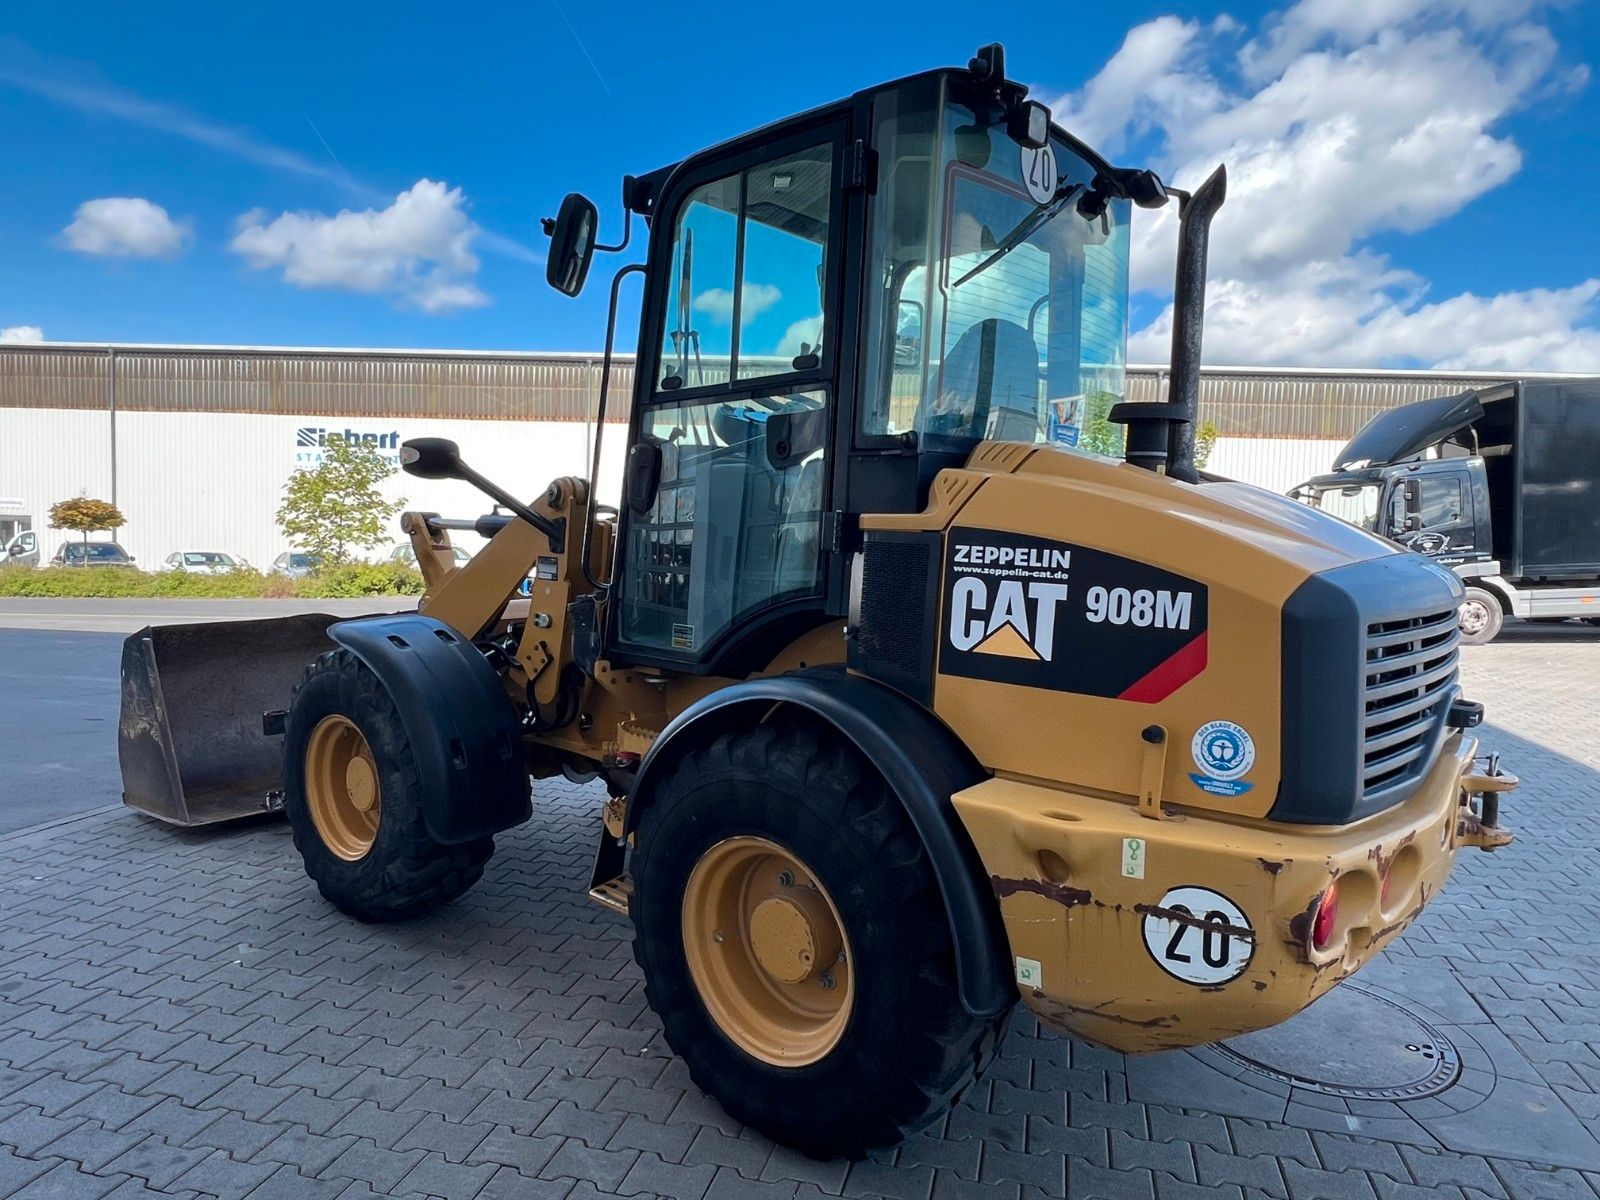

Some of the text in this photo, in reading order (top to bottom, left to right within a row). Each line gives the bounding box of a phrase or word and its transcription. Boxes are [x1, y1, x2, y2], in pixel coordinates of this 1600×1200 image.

[1030, 148, 1050, 192] 20
[953, 545, 1071, 568] ZEPPELIN
[953, 566, 1069, 580] www.zeppelin-cat.de
[950, 576, 1068, 661] CAT
[1086, 586, 1192, 630] 908M
[1166, 904, 1230, 968] 20
